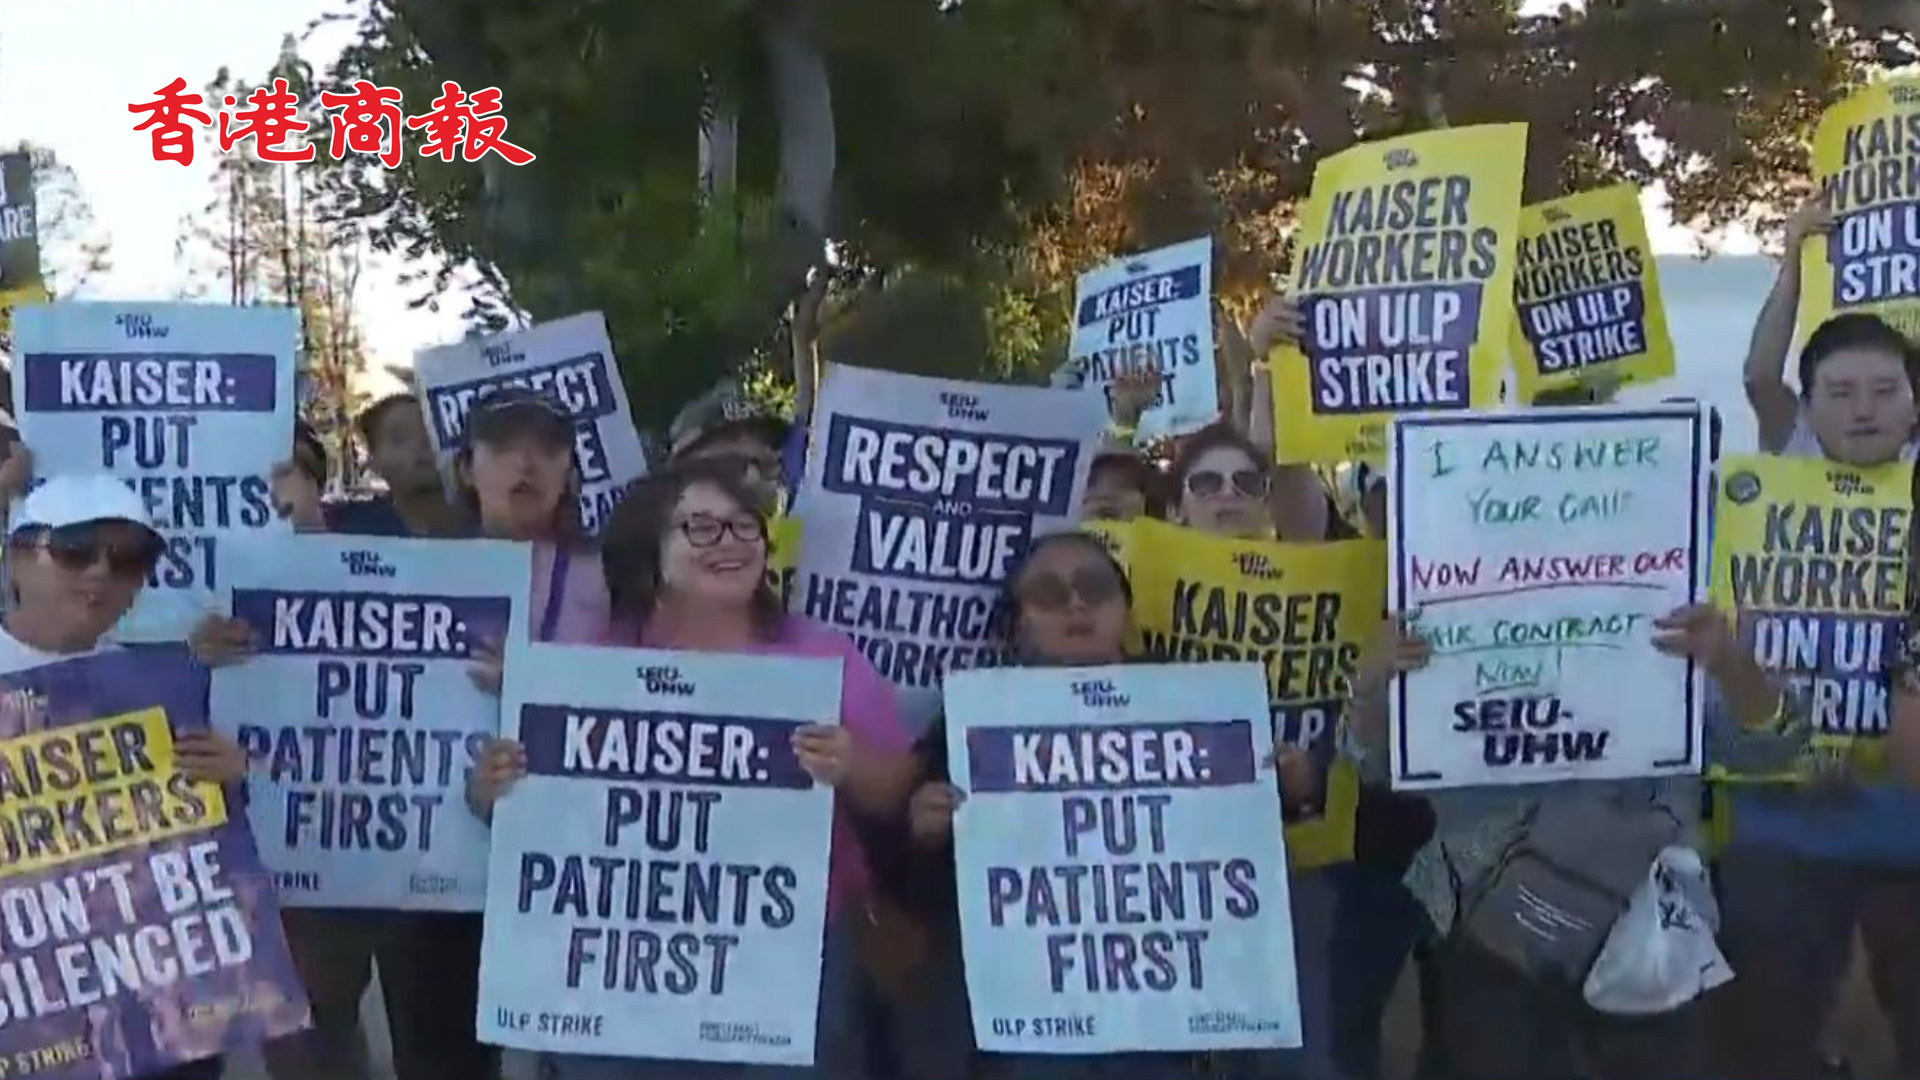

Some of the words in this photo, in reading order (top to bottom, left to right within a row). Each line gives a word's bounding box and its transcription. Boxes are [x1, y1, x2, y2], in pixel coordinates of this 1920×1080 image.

[1326, 175, 1472, 239] KAISER
[1843, 207, 1892, 257] ON
[1298, 226, 1498, 290] WORKERS
[1516, 219, 1618, 266] KAISER
[1094, 275, 1182, 319] KAISER:
[1315, 298, 1366, 350] ON
[1379, 291, 1461, 348] ULP
[1531, 302, 1573, 336] ON
[1577, 287, 1632, 326] ULP
[1108, 308, 1161, 343] PUT
[1539, 321, 1642, 369] STRIKE
[60, 360, 236, 405] KAISER:
[1319, 350, 1459, 408] STRIKE
[102, 416, 197, 469] PUT
[842, 424, 1065, 503] RESPECT
[1482, 439, 1661, 472] ANSWER
[930, 504, 972, 516] AND
[1466, 485, 1541, 524] YOUR
[868, 511, 1022, 579] VALUE
[1411, 554, 1481, 590] NOW
[1499, 556, 1624, 584] ANSWER
[1633, 547, 1684, 574] OUR
[274, 598, 467, 652] KAISER:
[1172, 578, 1343, 645] KAISER
[1493, 613, 1643, 648] CONTRACT
[1755, 617, 1820, 670] ON
[316, 661, 424, 720] PUT
[562, 714, 770, 781] KAISER:
[1012, 730, 1212, 784] KAISER:
[1482, 730, 1611, 767] UHW
[283, 792, 443, 850] FIRST
[604, 786, 722, 853] PUT
[1061, 795, 1172, 857] PUT
[150, 841, 235, 914] BE
[516, 851, 797, 929] PATIENTS
[986, 858, 1260, 927] PATIENTS
[0, 905, 253, 1028] ILENCED
[565, 926, 739, 996] FIRST
[1047, 930, 1210, 993] FIRST
[537, 1011, 604, 1036] STRIKE
[1033, 1015, 1098, 1036] STRIKE
